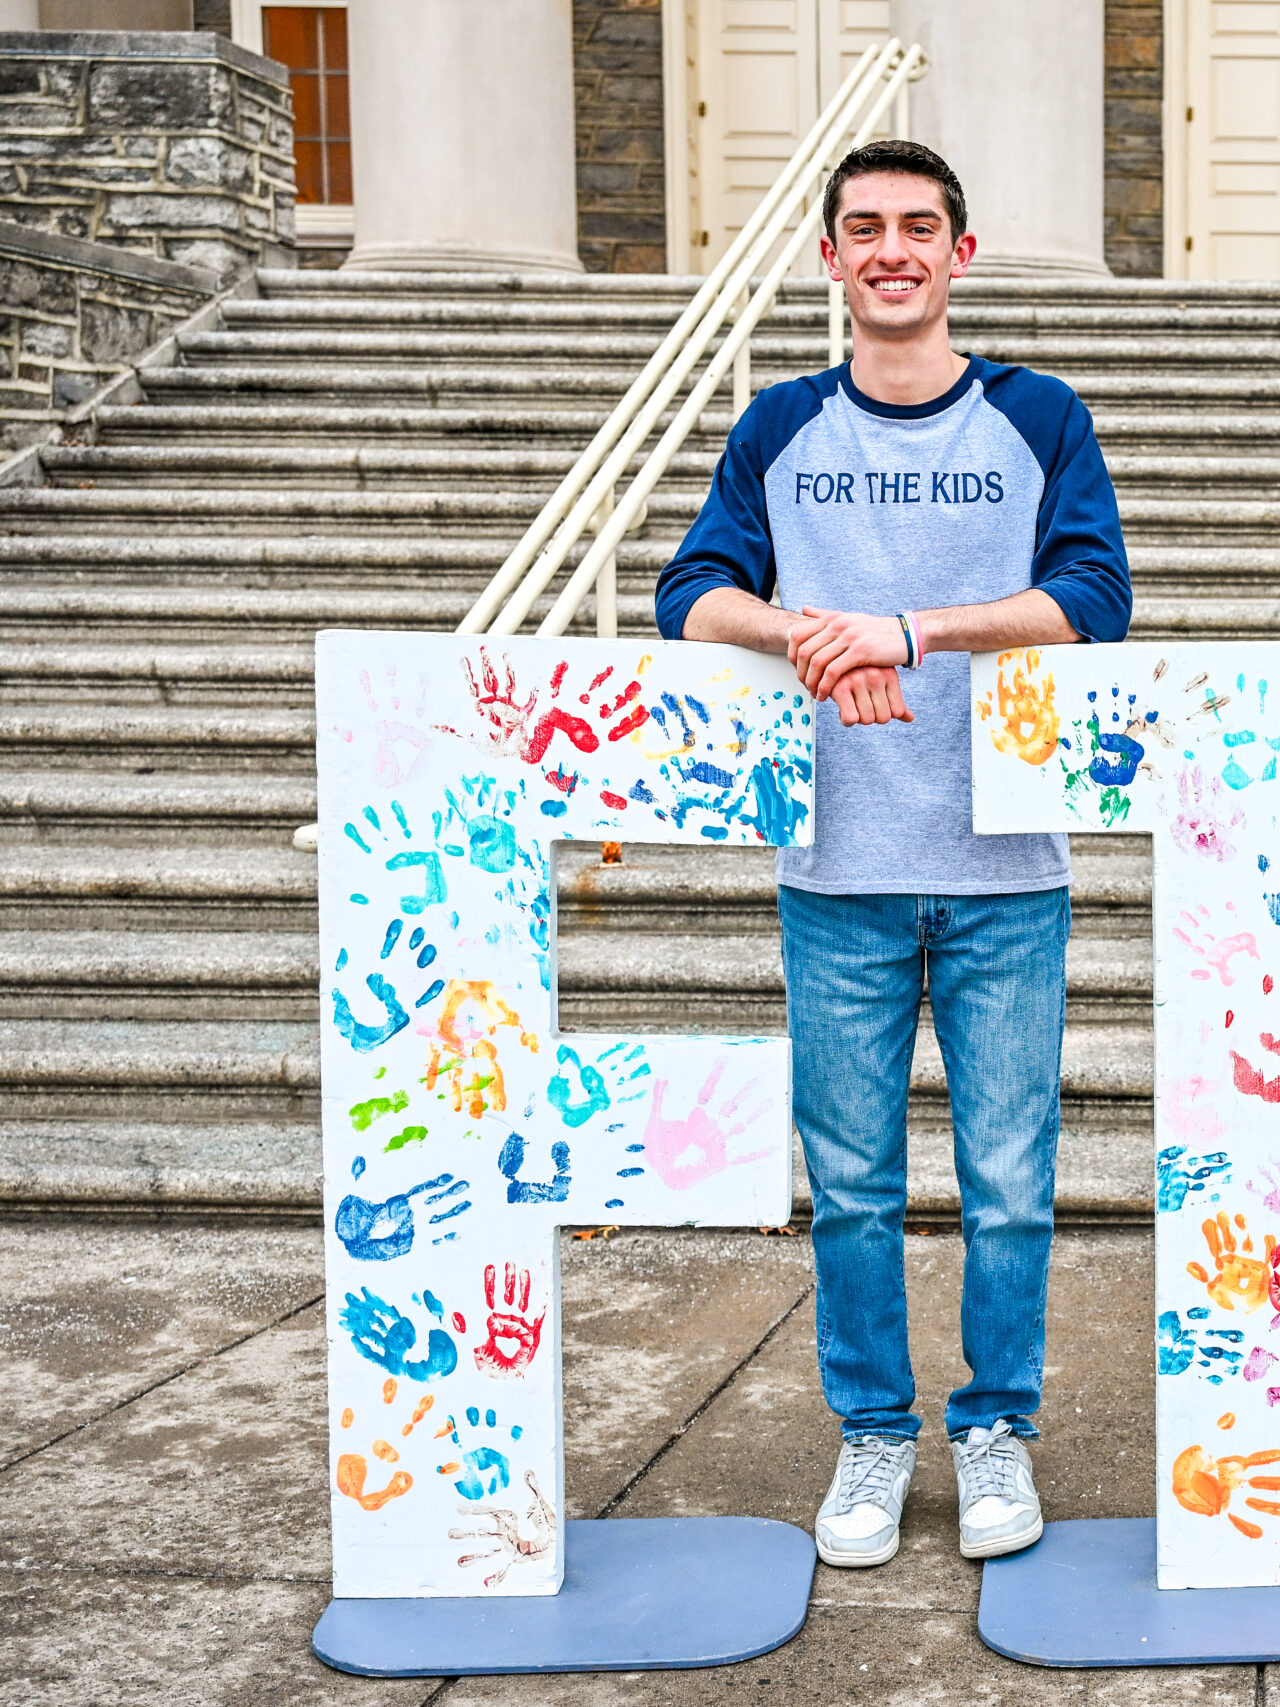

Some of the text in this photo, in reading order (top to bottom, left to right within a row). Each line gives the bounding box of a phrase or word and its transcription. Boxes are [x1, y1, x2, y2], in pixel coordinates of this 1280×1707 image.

[796, 471, 1003, 503] FOR THE KIDS
